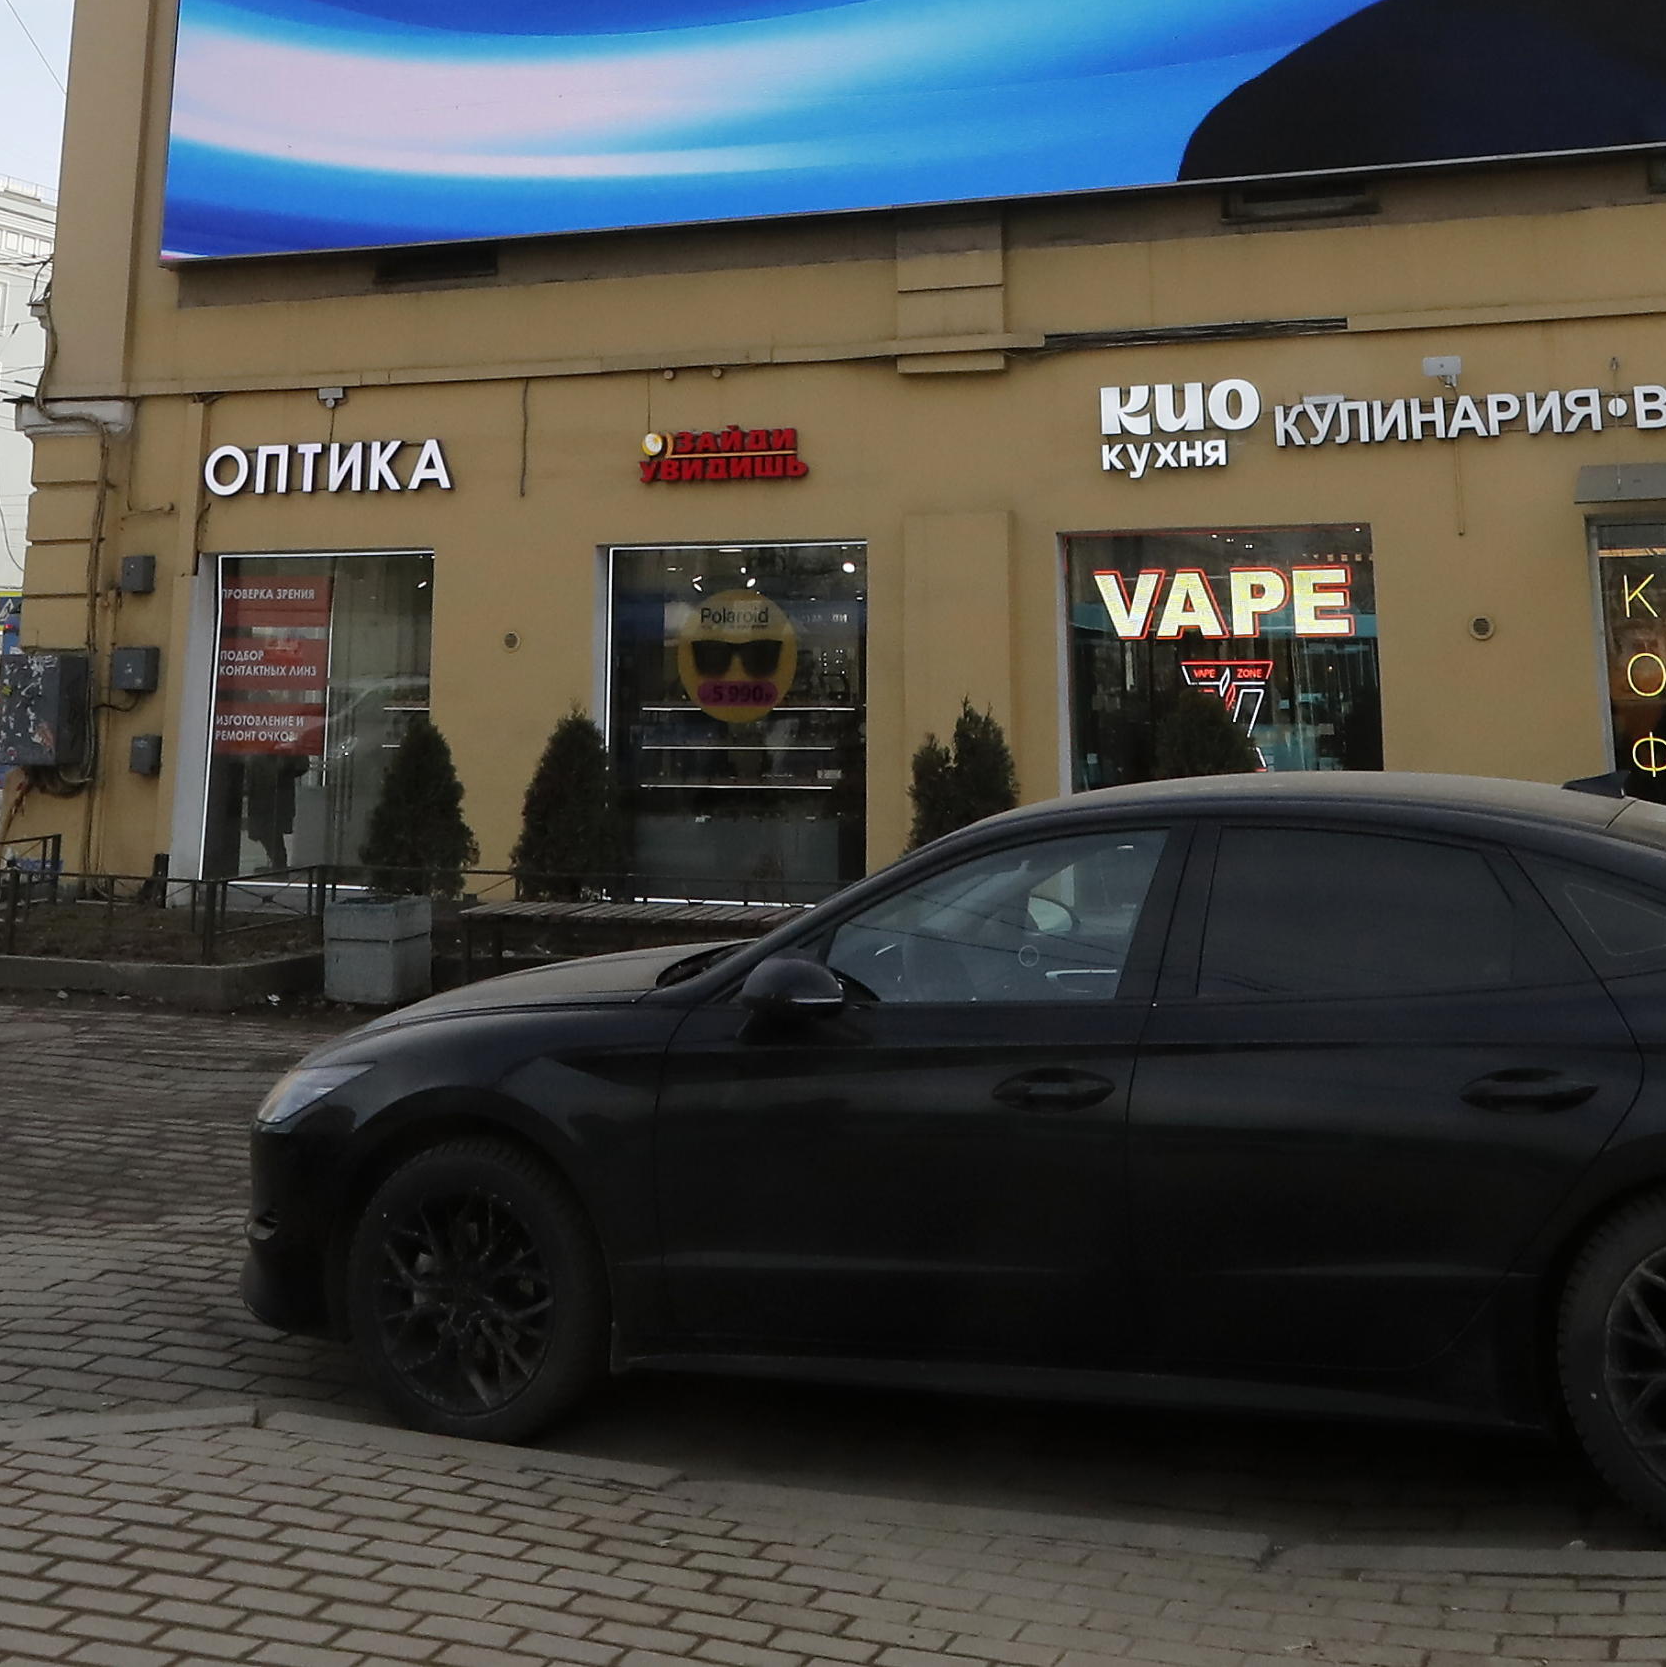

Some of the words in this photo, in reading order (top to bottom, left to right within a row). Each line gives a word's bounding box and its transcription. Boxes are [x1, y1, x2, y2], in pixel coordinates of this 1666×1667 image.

[1274, 388, 1603, 447] КУЛИНАРИЯ
[677, 425, 797, 452] ЗАЙДИ
[204, 438, 452, 497] ОПТИКА
[1101, 439, 1228, 479] кухня
[639, 455, 809, 483] УВИДИШЬ
[221, 588, 273, 600] ПРОВЕРКА
[276, 588, 315, 600] ЗРЕНИЯ
[1093, 564, 1356, 640] VAPE
[700, 607, 769, 624] Polaroid
[220, 650, 264, 662] ПОДБОР
[219, 665, 286, 677] КОНТАКТНЫХ
[289, 664, 317, 677] ЛИНЗ
[1193, 669, 1216, 678] VAPE
[1236, 668, 1263, 679] ZONE
[216, 715, 294, 727] ИЗГОТОВЛЕНИЕ
[296, 715, 304, 727] И
[215, 730, 256, 742] РЕМОНТ
